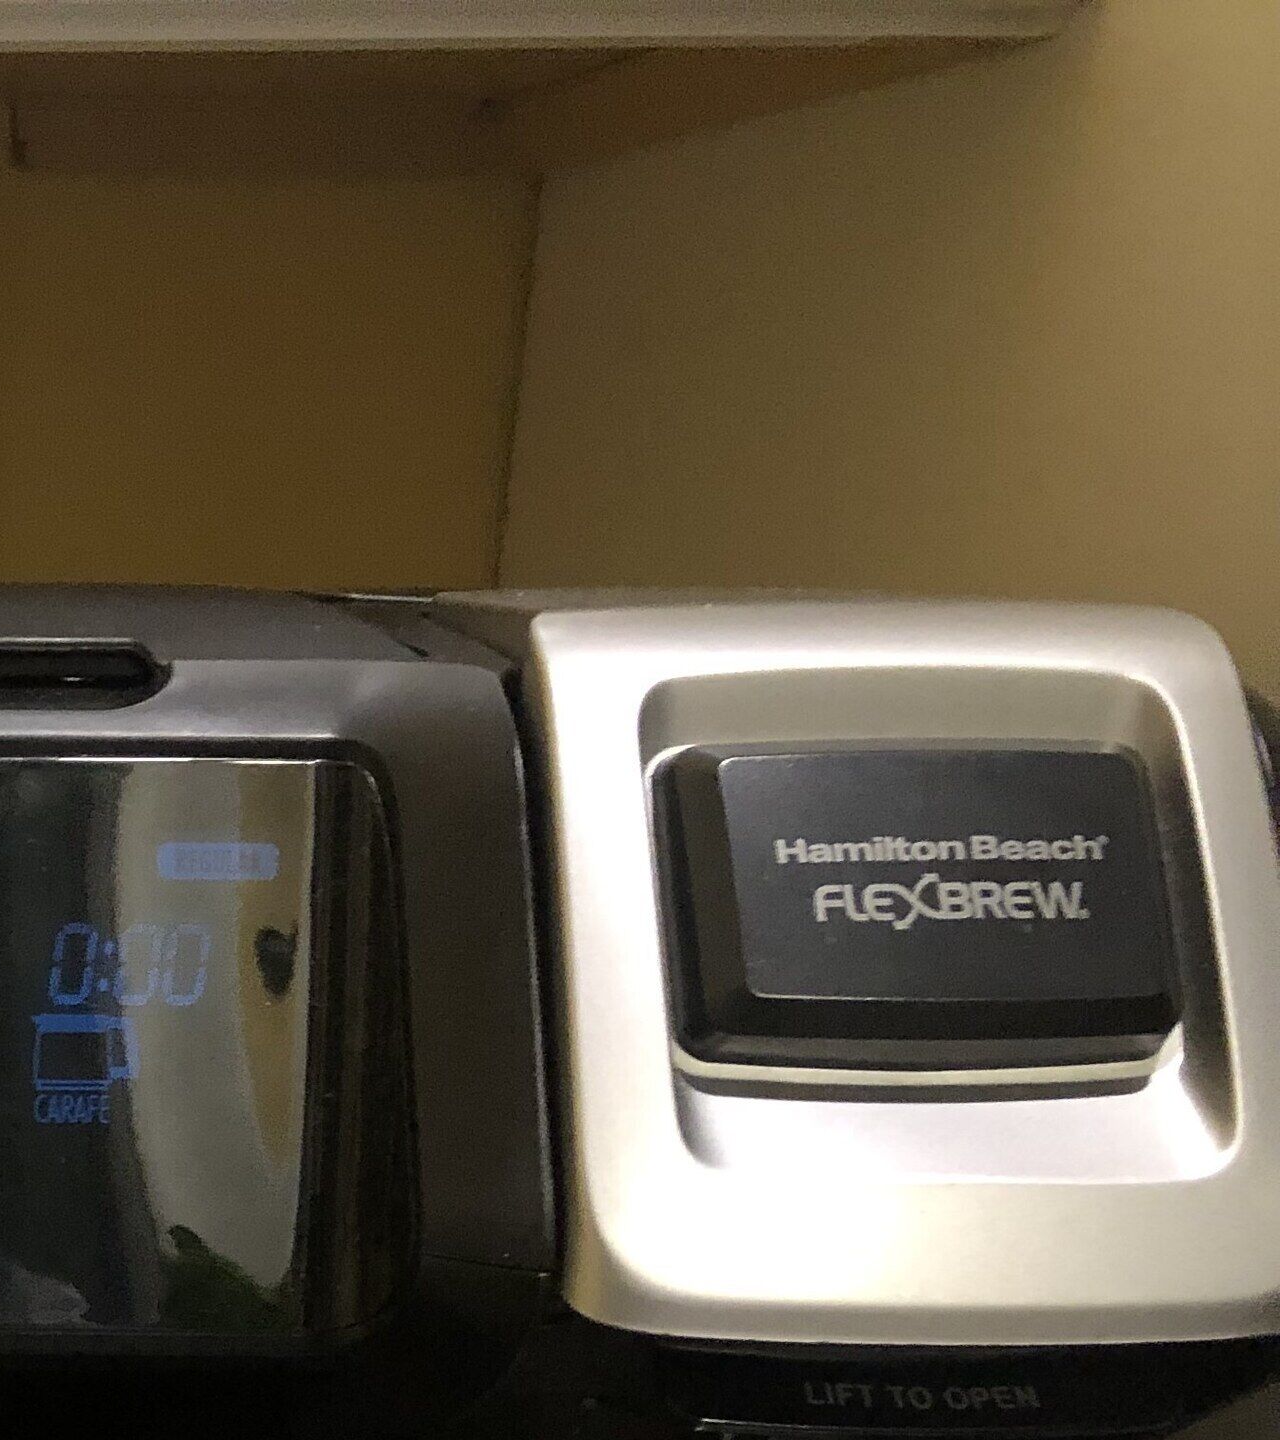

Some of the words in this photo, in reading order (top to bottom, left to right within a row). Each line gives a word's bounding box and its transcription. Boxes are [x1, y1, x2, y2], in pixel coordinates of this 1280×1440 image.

[775, 836, 967, 864] Hamilton
[970, 836, 1101, 861] Beach
[814, 873, 1086, 930] FLEXBREW
[47, 922, 211, 1006] 0:00
[34, 1093, 111, 1124] CARAFE
[804, 1381, 874, 1408] LIFT
[884, 1386, 933, 1410] TO
[943, 1385, 1040, 1410] OPEN
